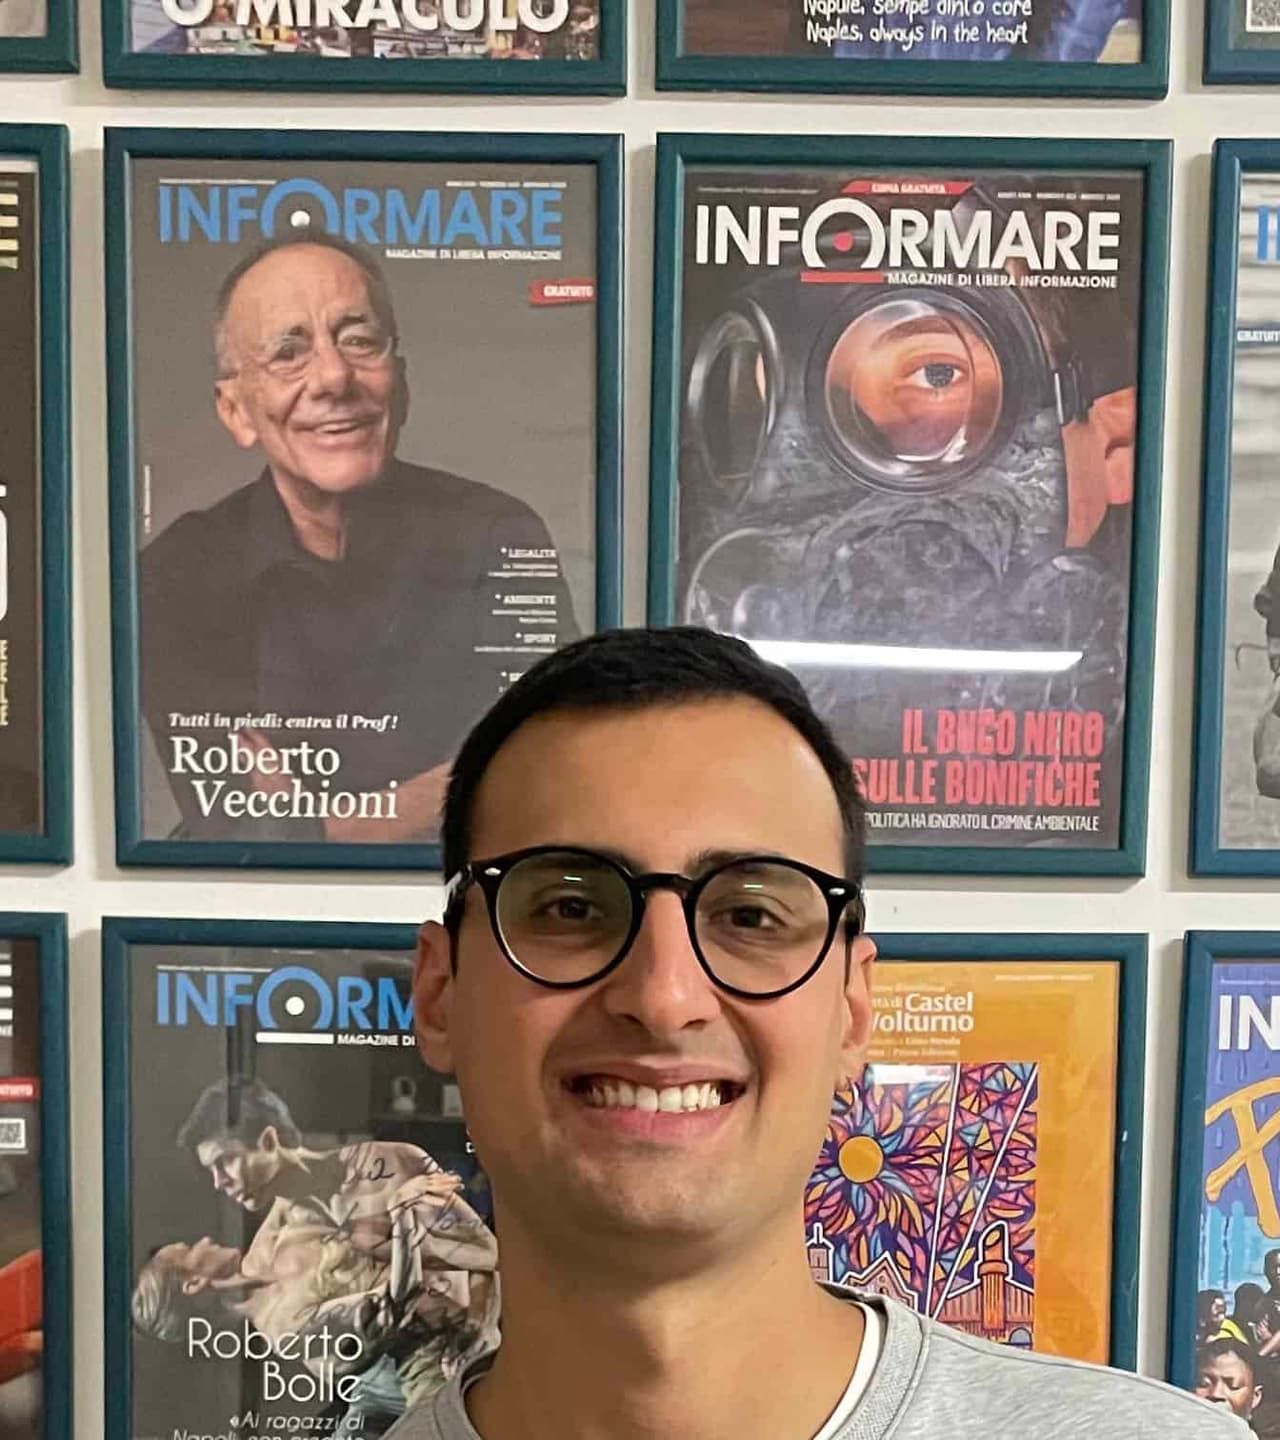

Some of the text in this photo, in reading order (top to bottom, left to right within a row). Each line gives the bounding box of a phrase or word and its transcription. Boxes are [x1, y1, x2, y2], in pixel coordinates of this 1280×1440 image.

[807, 19, 1028, 50] Naples, always the heart
[158, 178, 564, 245] INFORMARE
[695, 198, 1120, 272] INFORMARE
[543, 284, 594, 297] GRATUITO
[888, 273, 1117, 289] MAGAZINE DI LIBERA INFORMAZIONE
[168, 712, 349, 729] Tutti in entra il
[902, 708, 1104, 757] IL NERO
[170, 735, 341, 776] Roberto
[191, 780, 399, 819] Vecchioni
[944, 760, 1101, 807] BONIFICHE
[905, 992, 973, 1012] Castel
[337, 1034, 416, 1046] MAGAZINE DI
[188, 1318, 363, 1361] Roberto
[264, 1361, 361, 1403] Bolle
[266, 1414, 365, 1434] ragazzi di
